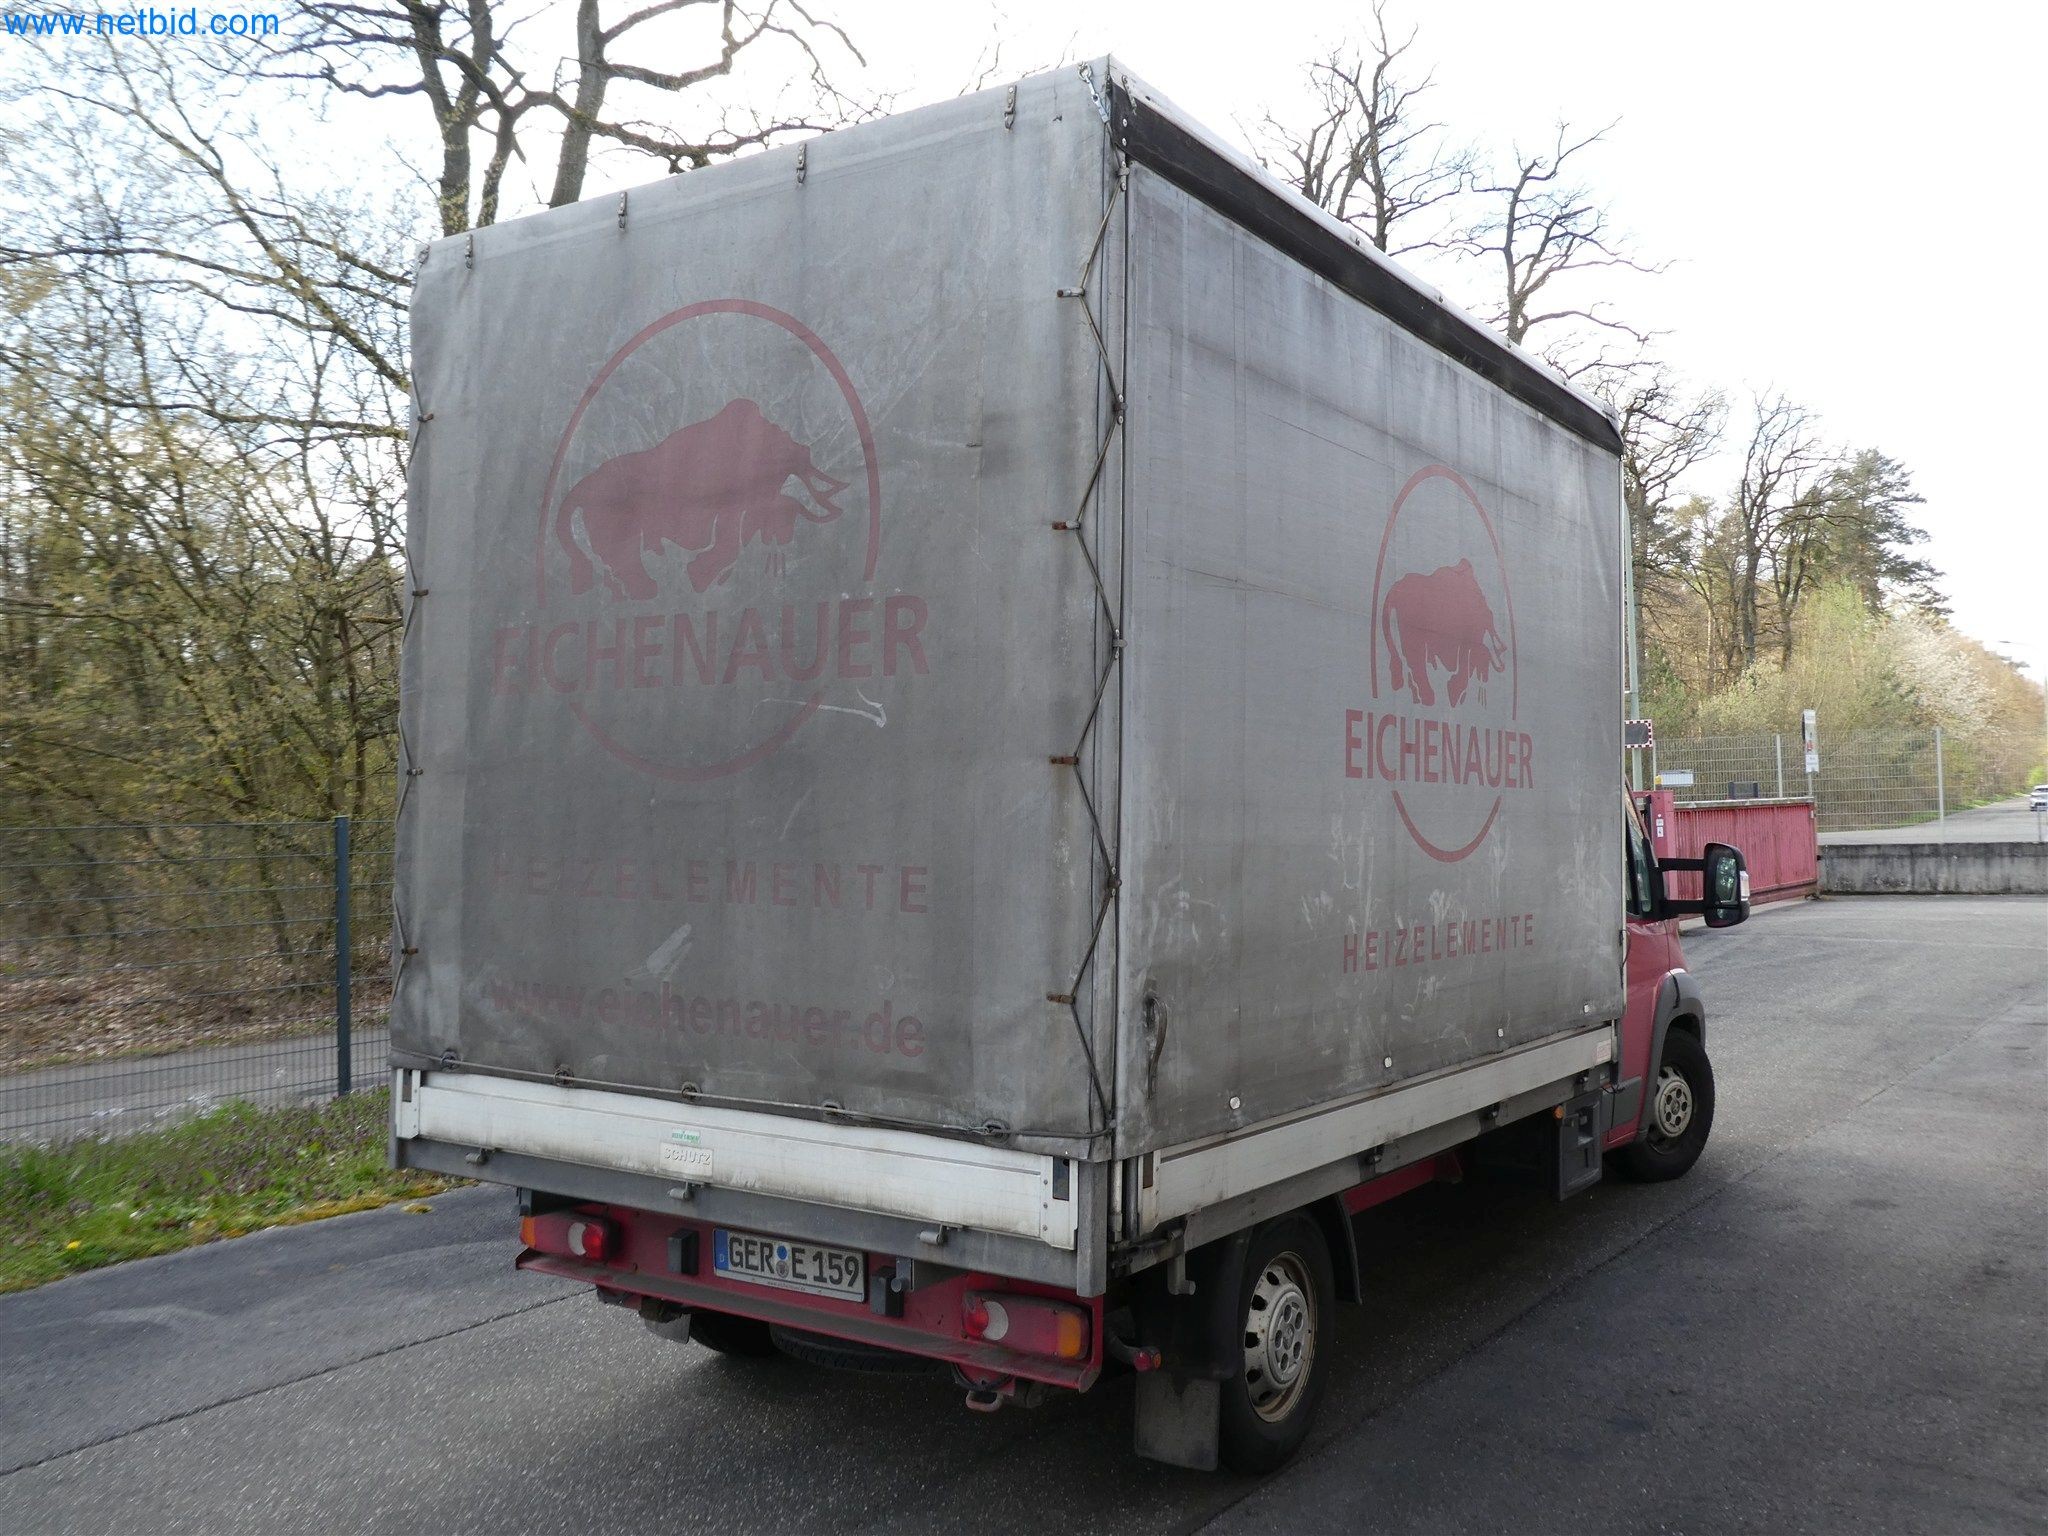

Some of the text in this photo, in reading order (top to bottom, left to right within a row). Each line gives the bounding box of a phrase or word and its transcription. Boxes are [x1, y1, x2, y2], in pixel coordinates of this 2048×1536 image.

[491, 594, 930, 697] EICHENAUER
[1345, 708, 1534, 789] EICHENAUER
[493, 856, 928, 913] HEZELEMENTE
[1343, 914, 1534, 974] HEIZELEMENTE
[488, 977, 926, 1057] wwweichenauer.de
[729, 1236, 860, 1287] GER E 159
